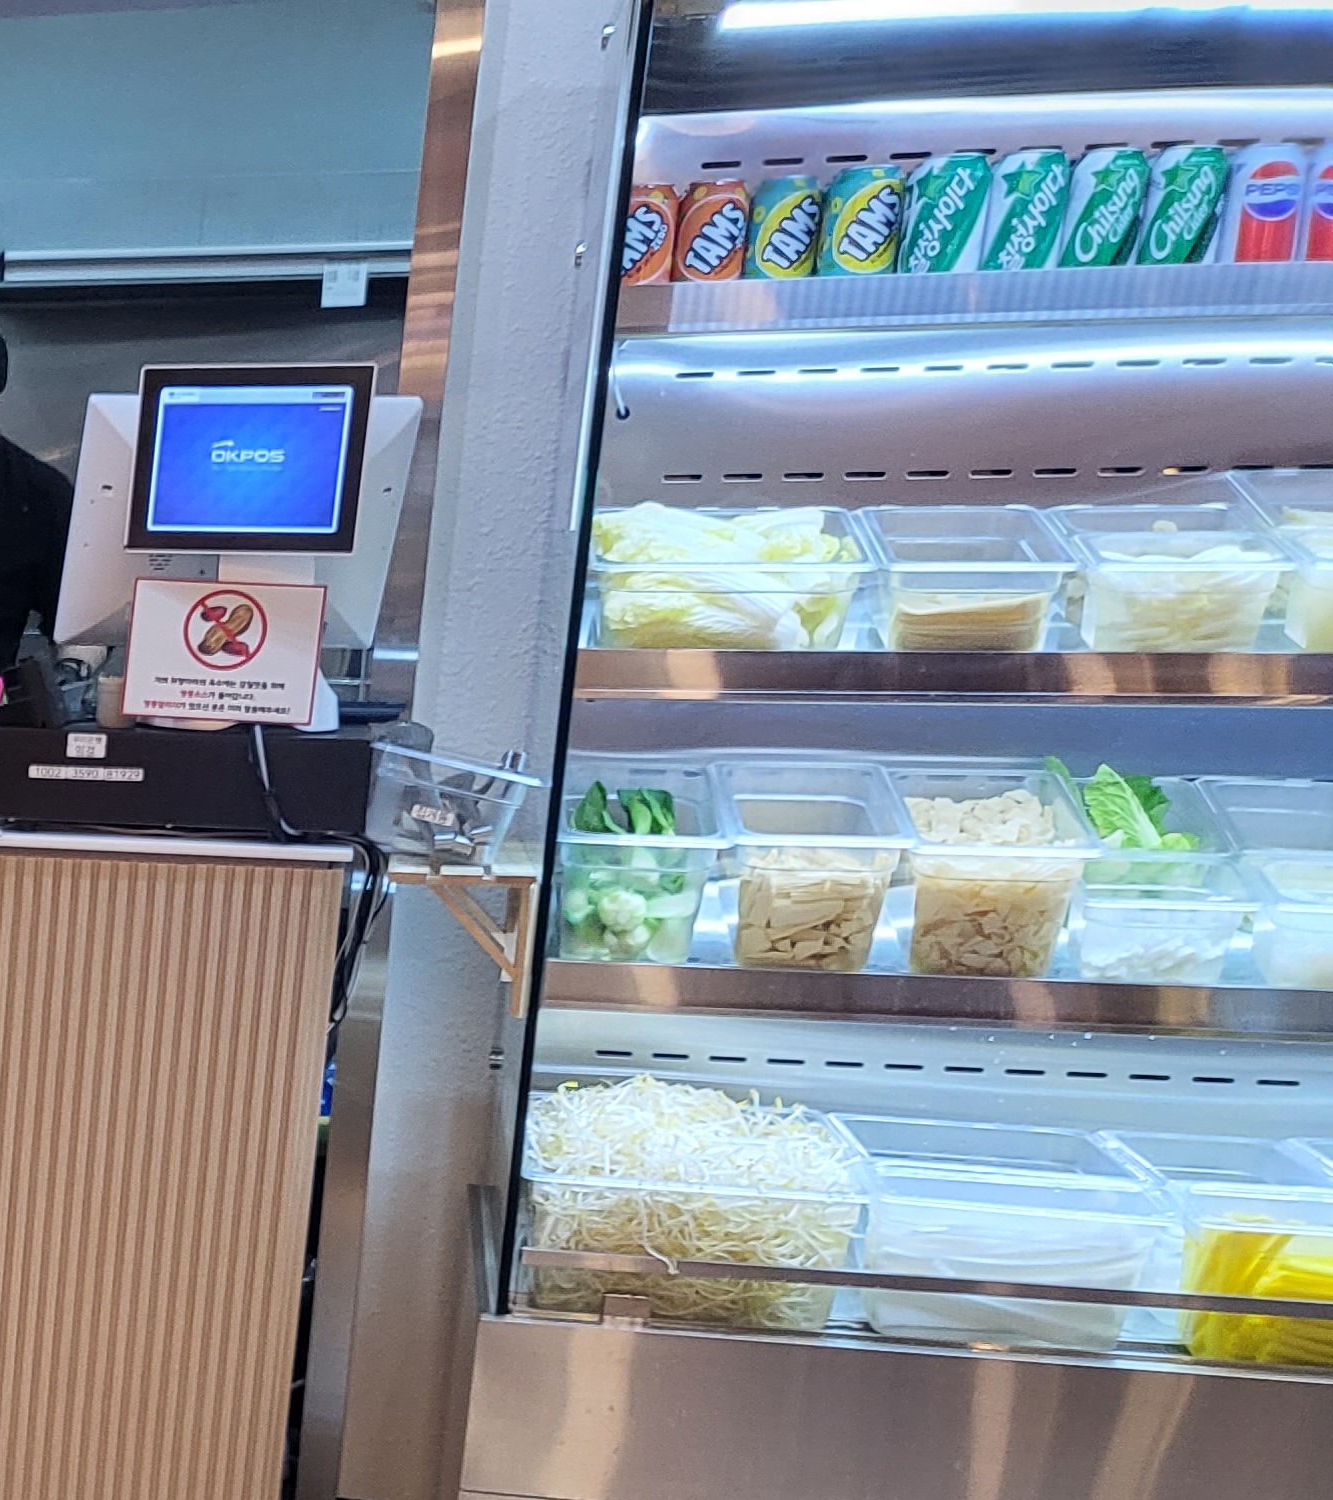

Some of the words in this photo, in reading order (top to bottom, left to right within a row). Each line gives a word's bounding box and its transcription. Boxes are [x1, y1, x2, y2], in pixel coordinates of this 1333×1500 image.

[621, 204, 662, 277] AMS
[685, 199, 746, 275] TAMS
[761, 195, 820, 270] TAMS
[837, 185, 901, 263] TAMS
[1074, 167, 1140, 263] Chilsung
[1149, 165, 1215, 260] Chilsung
[211, 445, 285, 463] OKPOS
